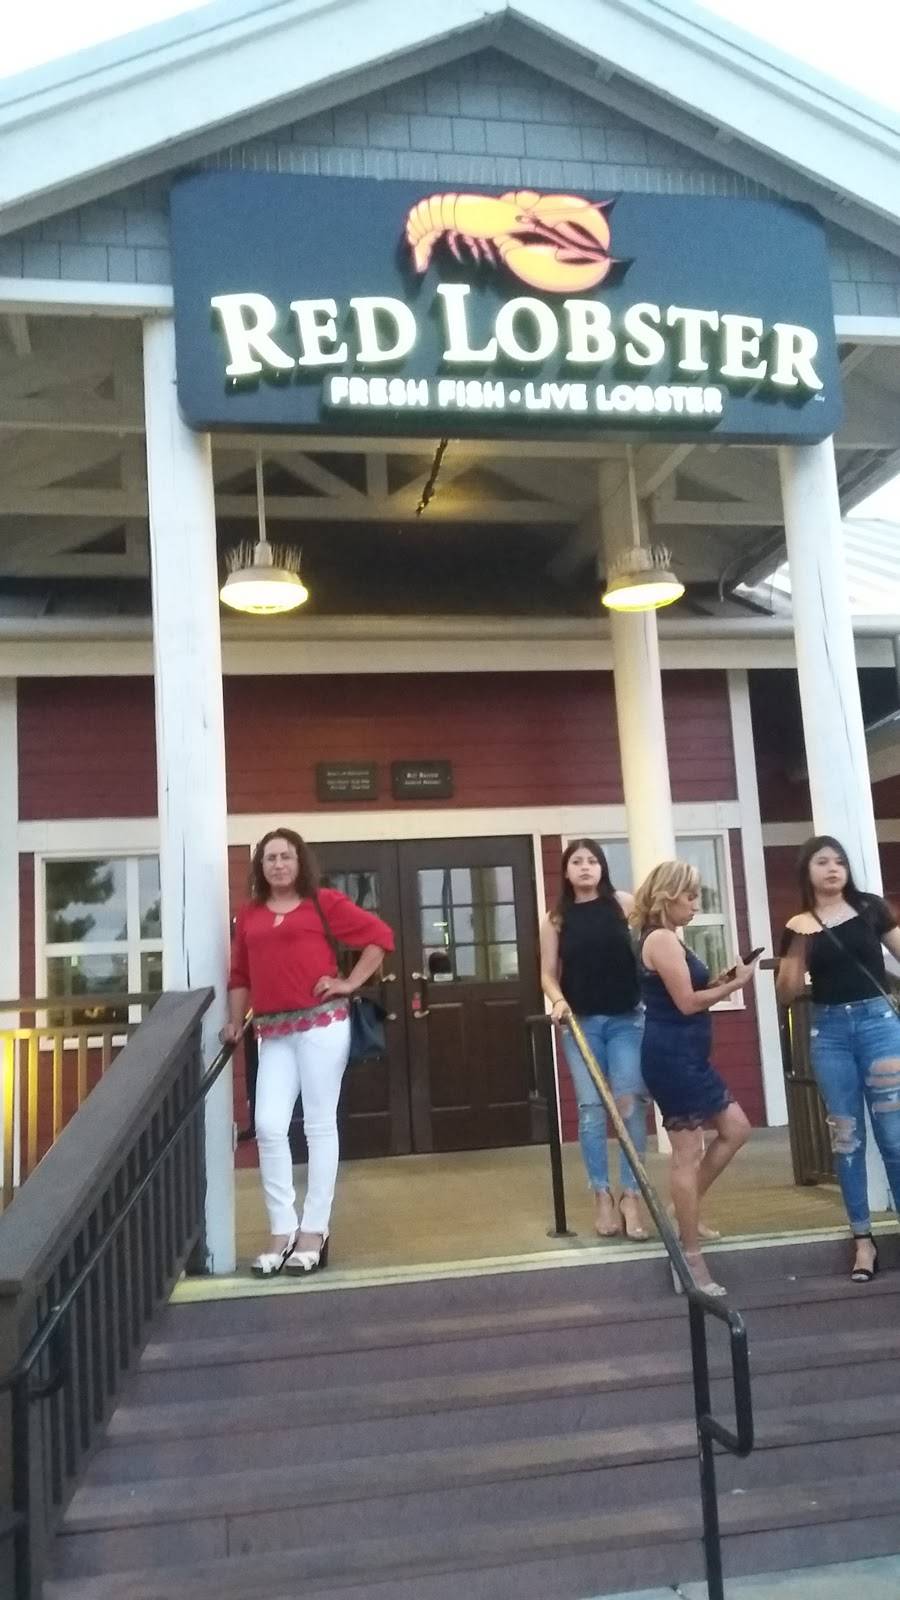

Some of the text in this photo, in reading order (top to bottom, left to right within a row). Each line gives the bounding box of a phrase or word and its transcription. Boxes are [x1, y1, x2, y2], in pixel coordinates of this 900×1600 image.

[211, 283, 824, 390] RED LOBSTER
[330, 376, 723, 413] FRESH FISH LIVE LOBSTER
